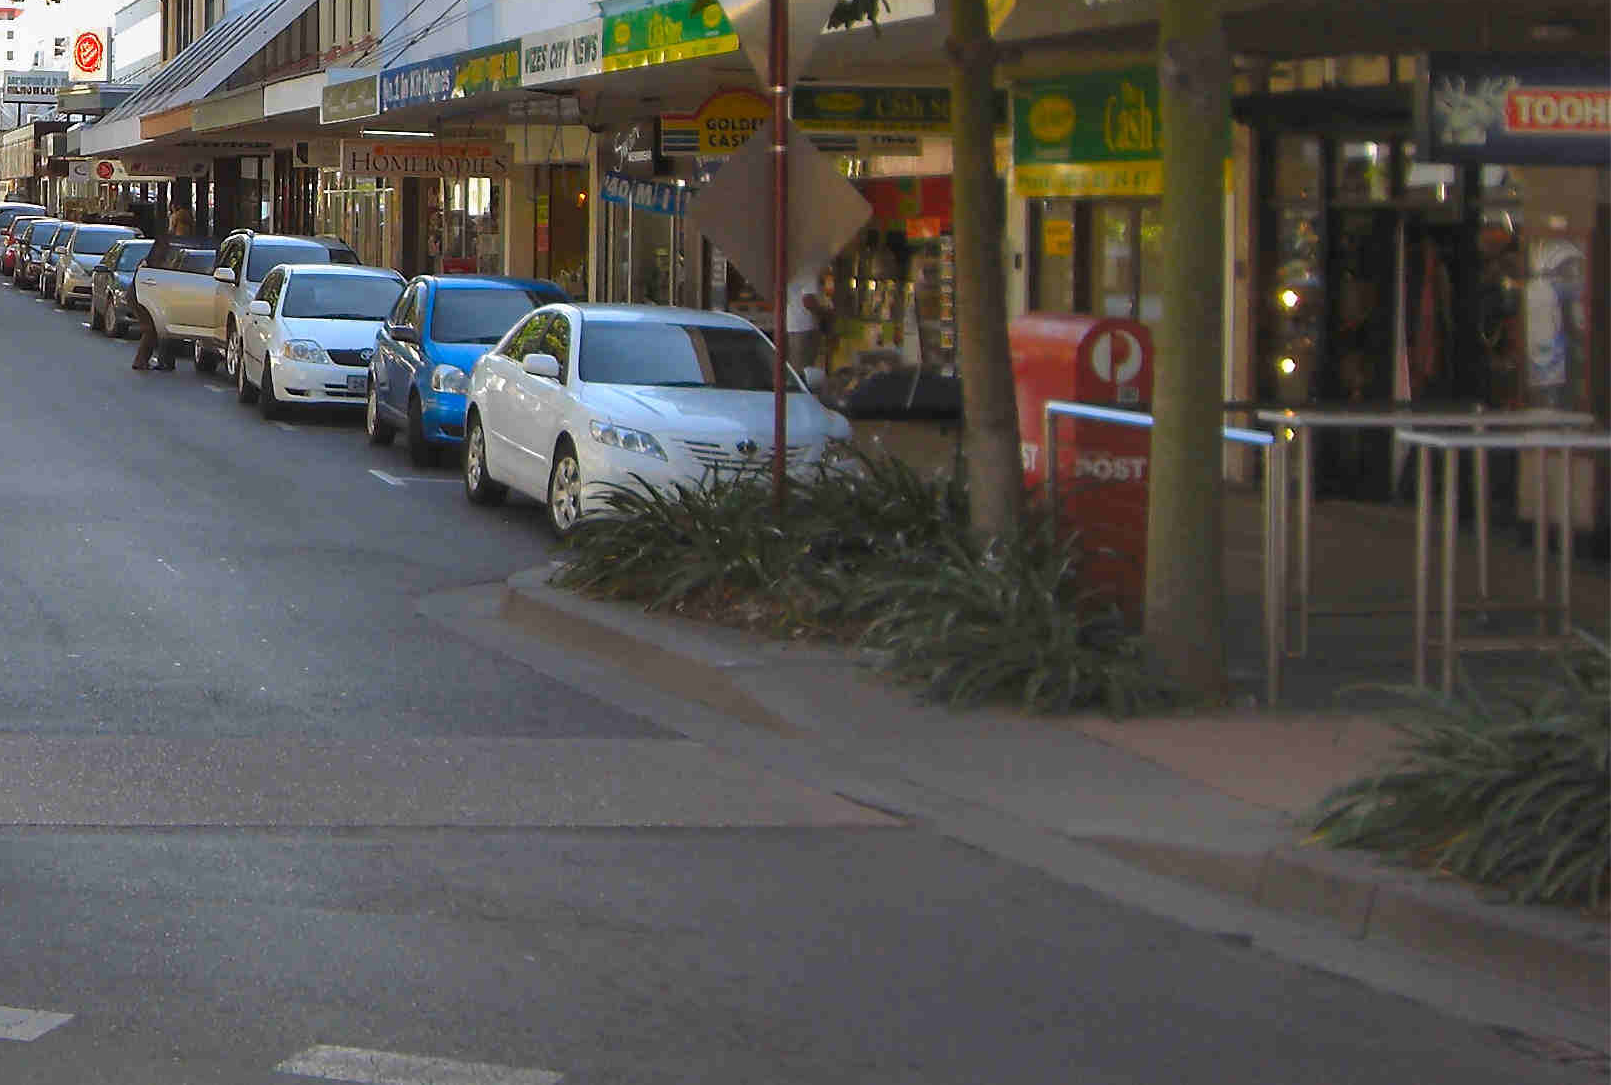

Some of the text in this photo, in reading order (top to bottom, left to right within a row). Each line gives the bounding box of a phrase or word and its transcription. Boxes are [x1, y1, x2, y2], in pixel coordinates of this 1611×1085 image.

[548, 39, 570, 69] CITY
[572, 32, 597, 65] NEWS
[350, 151, 509, 174] HOMEBODIES
[1074, 456, 1148, 482] POST
